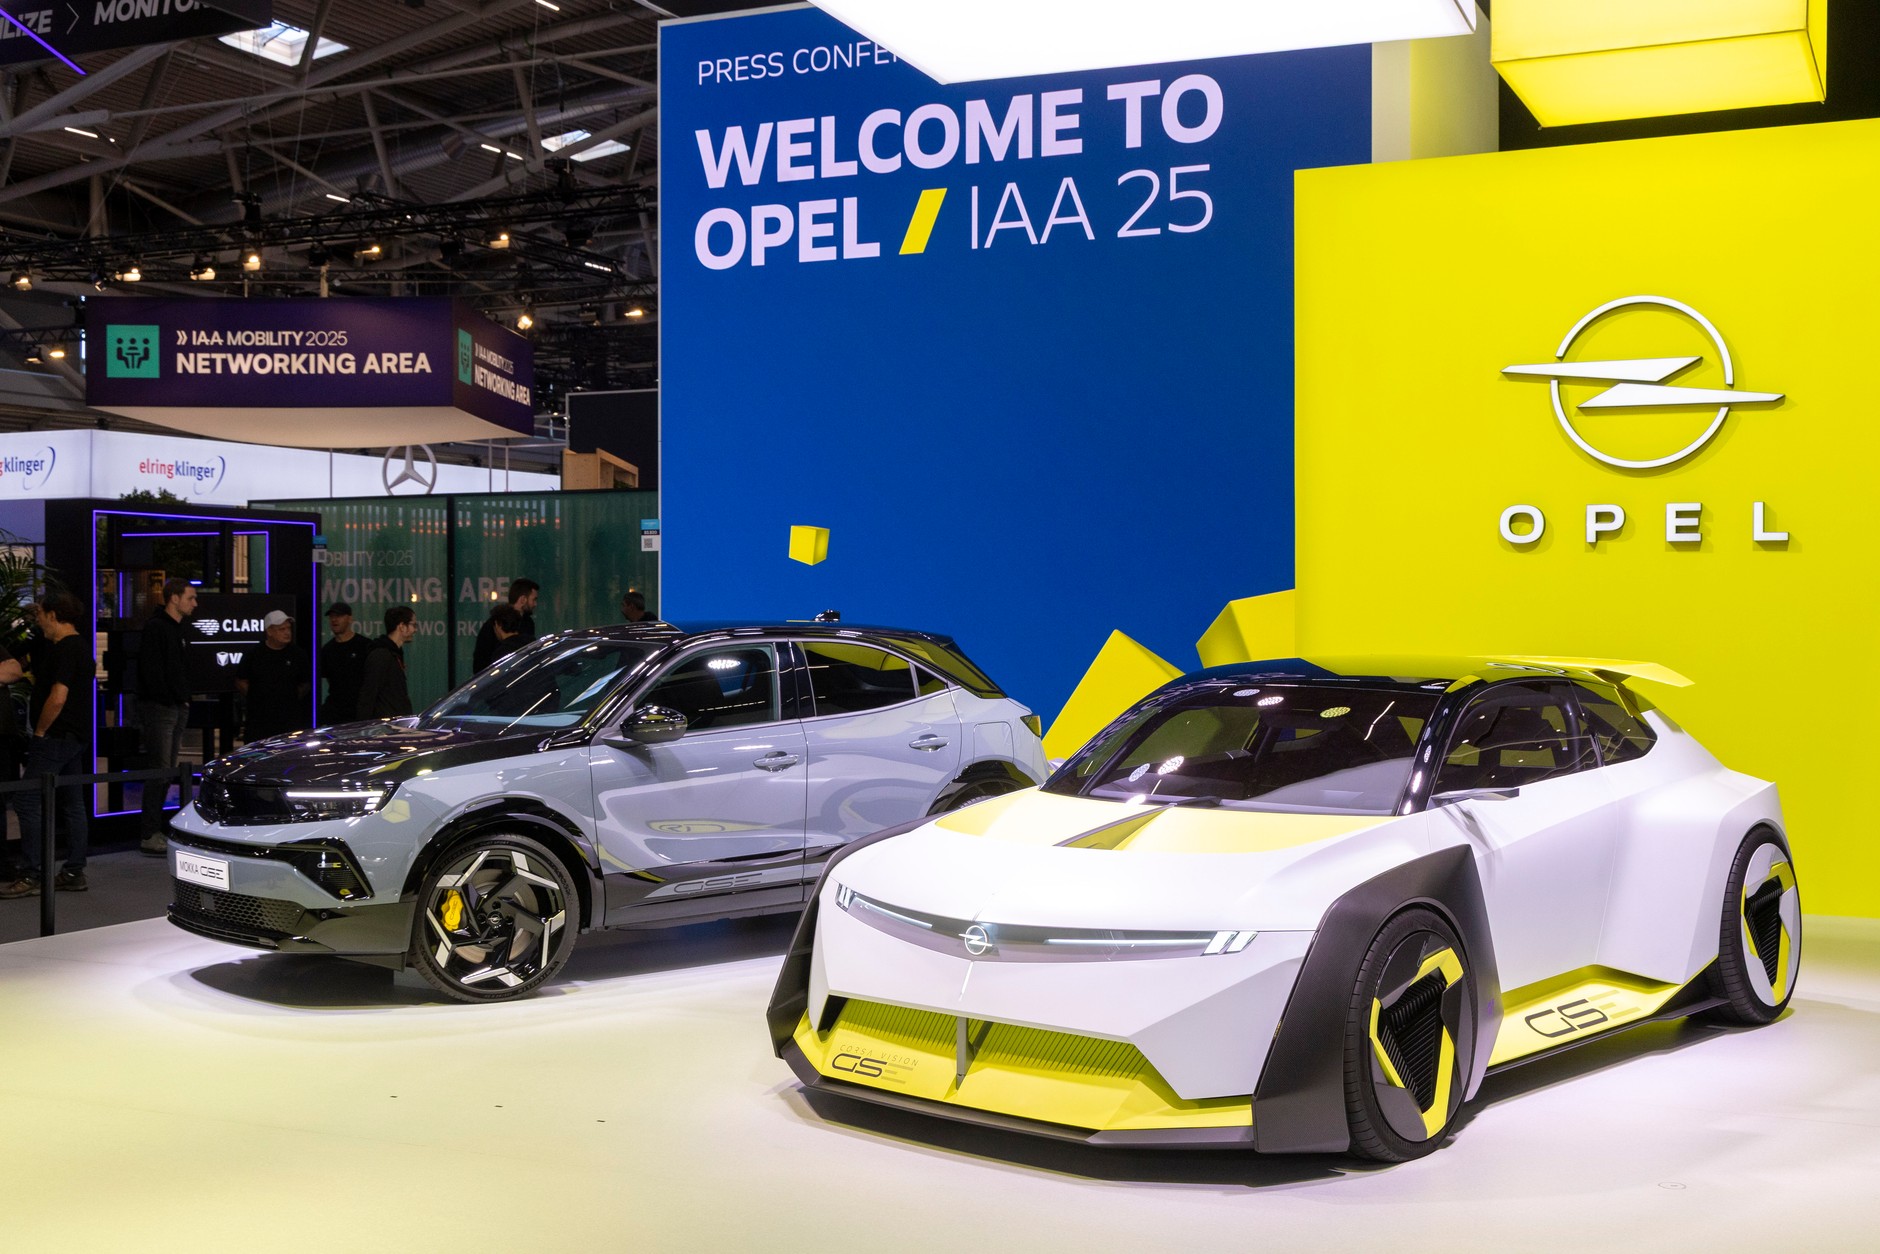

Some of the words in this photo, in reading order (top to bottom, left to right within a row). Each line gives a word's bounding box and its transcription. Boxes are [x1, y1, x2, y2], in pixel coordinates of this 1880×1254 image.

[698, 51, 785, 86] PRESS
[792, 41, 898, 74] CONFE
[695, 88, 1083, 189] WELCOME
[1107, 73, 1224, 149] TO
[694, 196, 880, 270] OPEL
[970, 177, 1095, 249] IAA
[1117, 164, 1214, 238] 25
[192, 331, 224, 346] IAA
[226, 331, 303, 346] MOBILITY
[305, 331, 348, 346] 2025
[176, 353, 356, 374] NETWORKING
[362, 353, 432, 374] AREA
[474, 363, 515, 401] NETWORKING
[515, 383, 531, 407] AREA
[139, 458, 215, 481] elringklinger
[1500, 501, 1790, 545] OPEL
[377, 550, 414, 567] 2025
[459, 577, 515, 603] ARE
[839, 1044, 873, 1057] CORSA
[881, 1053, 920, 1067] VISION
